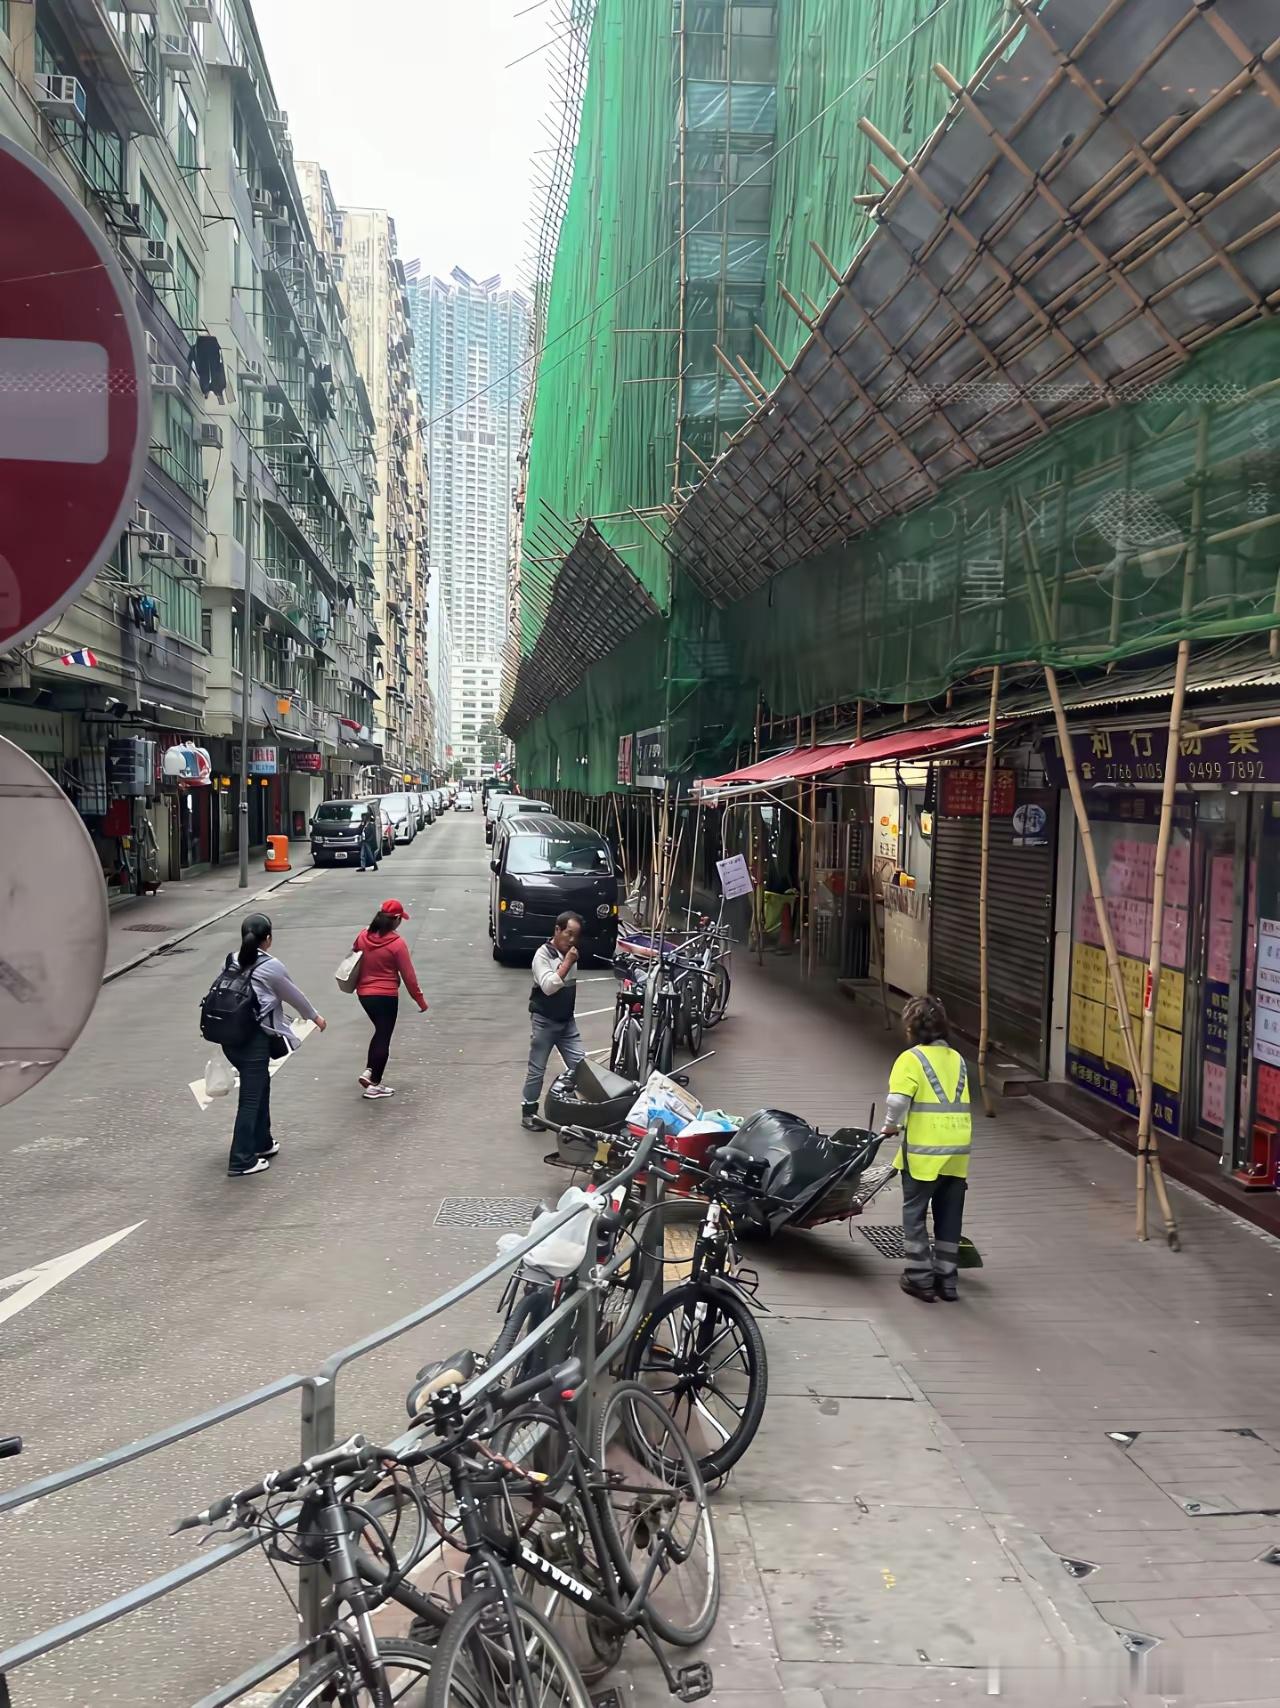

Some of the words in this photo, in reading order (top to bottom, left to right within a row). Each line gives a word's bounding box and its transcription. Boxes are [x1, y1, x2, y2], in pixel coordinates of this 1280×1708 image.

[1106, 763, 1132, 779] 2766
[1188, 761, 1222, 780] 9499
[1228, 760, 1265, 779] 7892
